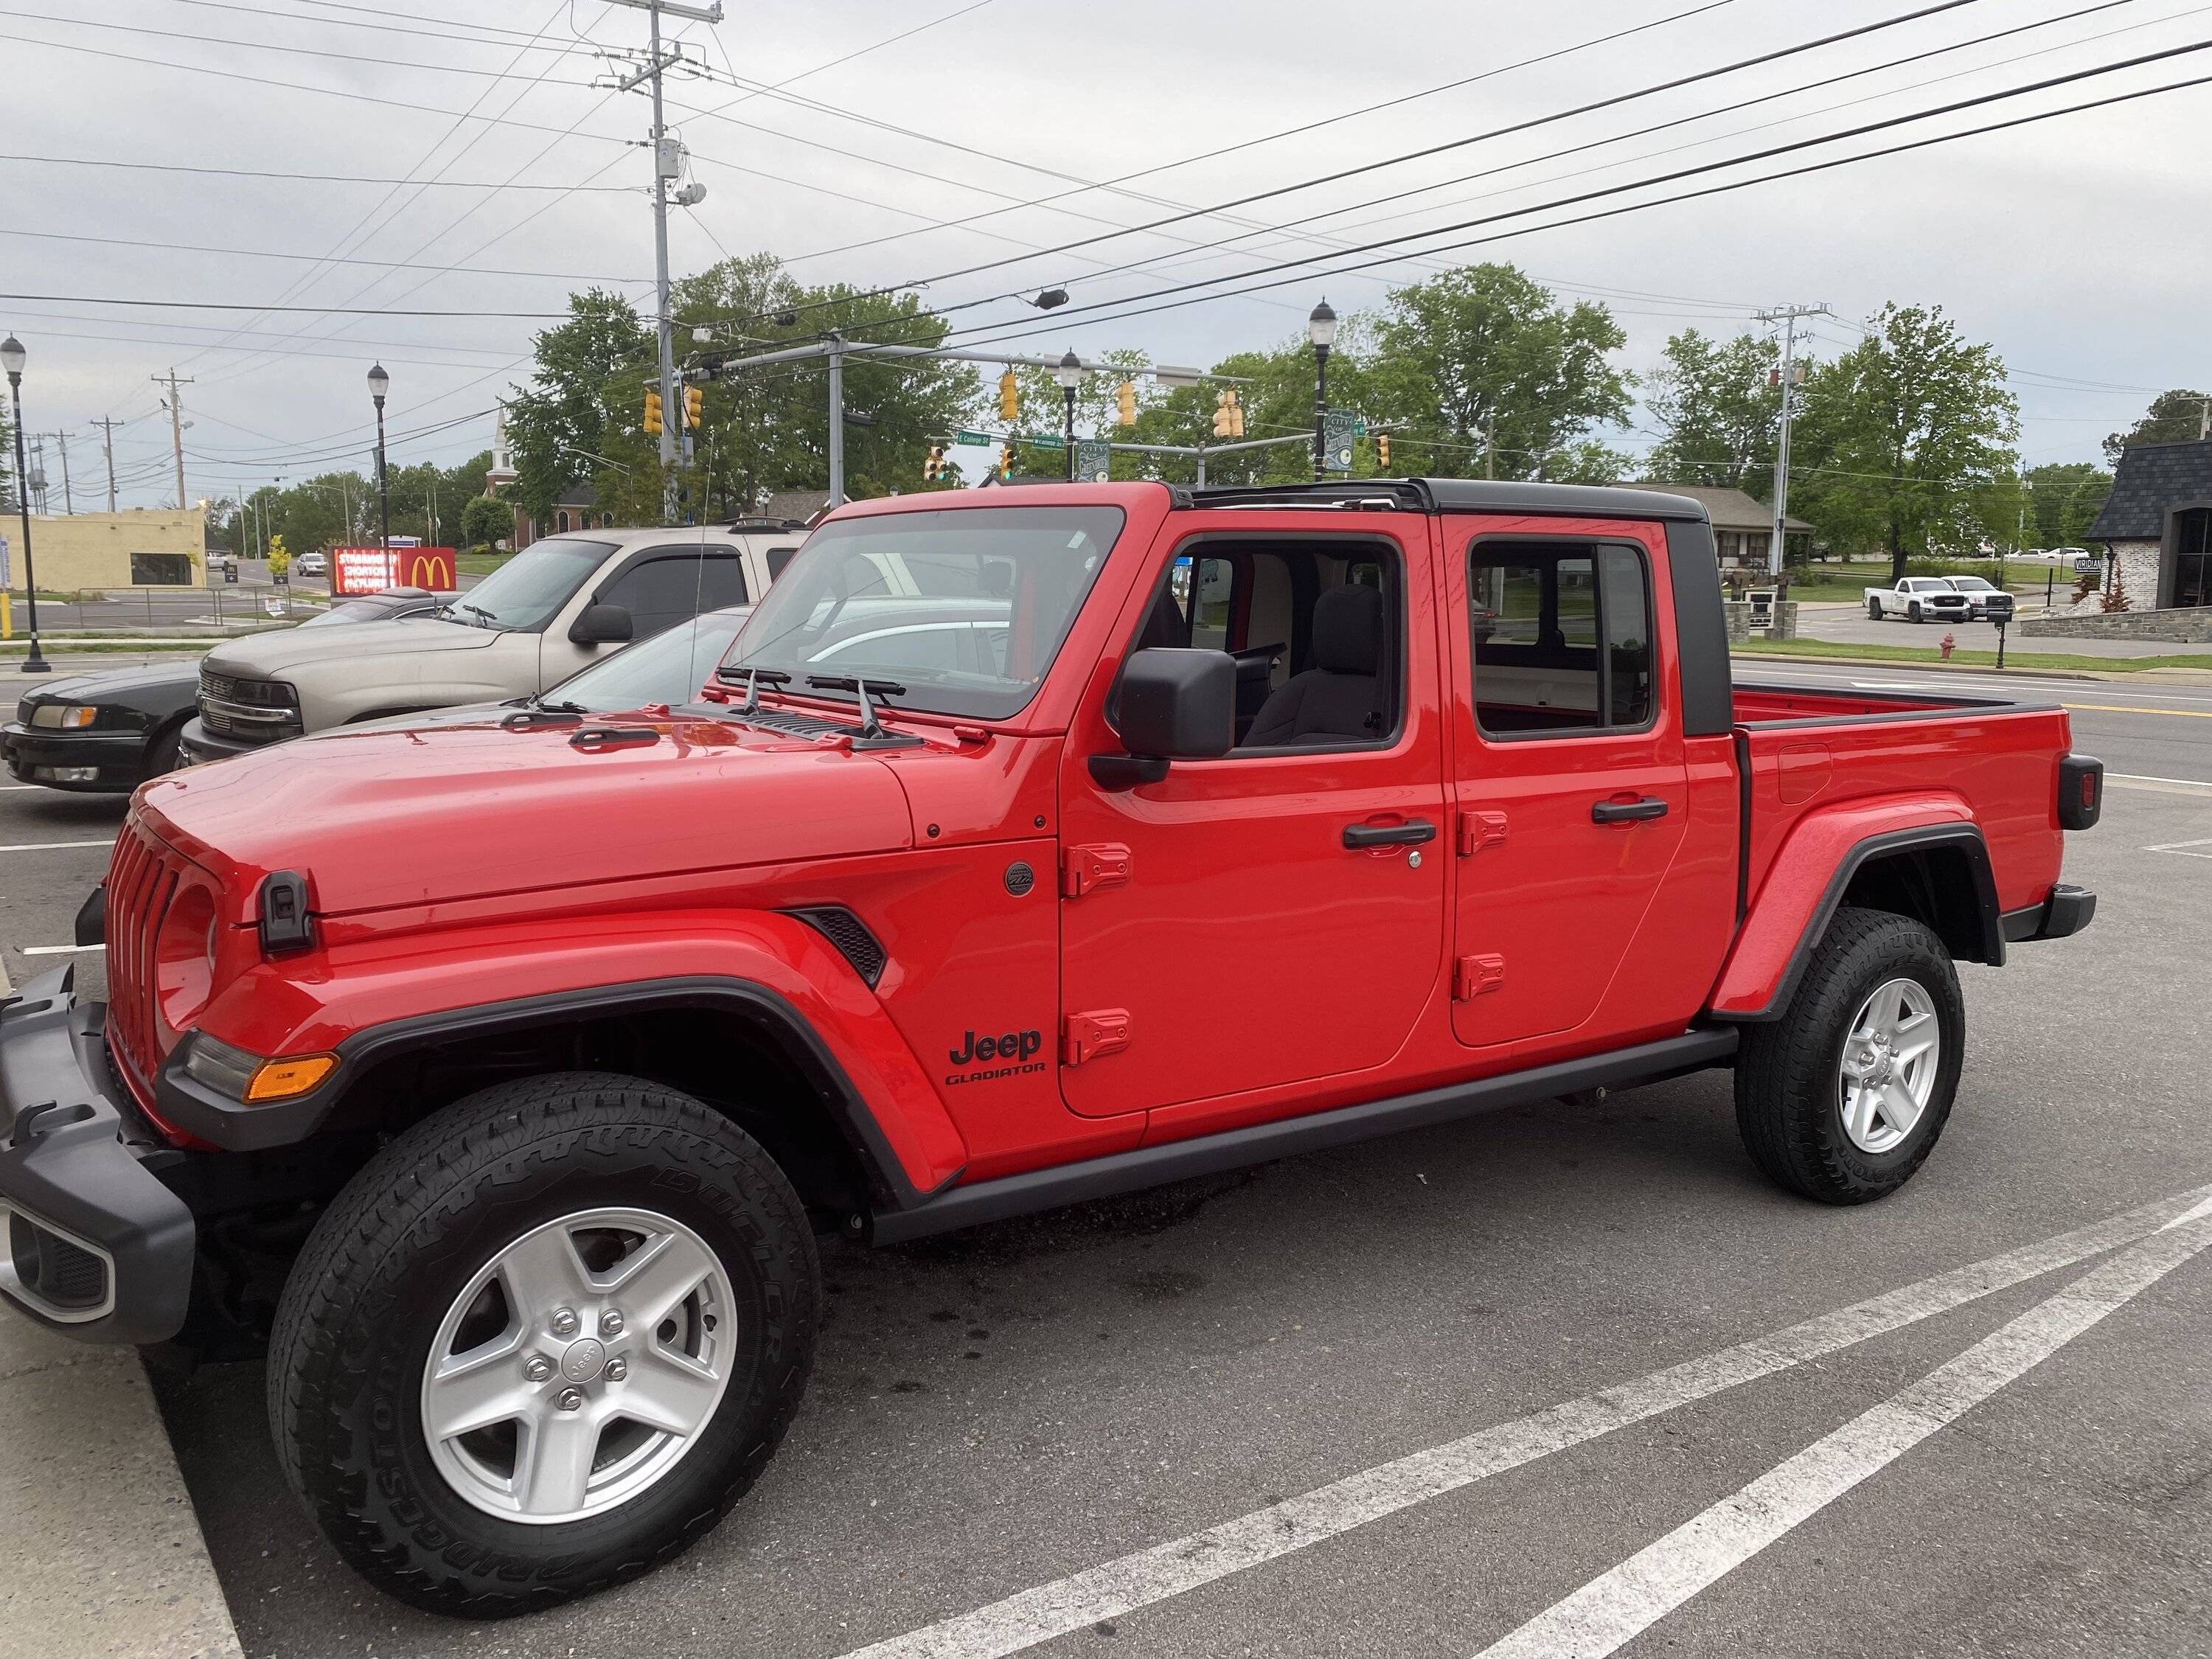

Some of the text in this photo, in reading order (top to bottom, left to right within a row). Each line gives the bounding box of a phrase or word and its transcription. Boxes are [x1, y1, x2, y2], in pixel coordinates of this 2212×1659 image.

[963, 436, 981, 445] College
[2076, 559, 2101, 570] VIRIDIAN
[949, 1029, 1041, 1065] Jeep
[945, 1062, 1046, 1085] GLADIATOR
[571, 1346, 595, 1377] Jeep
